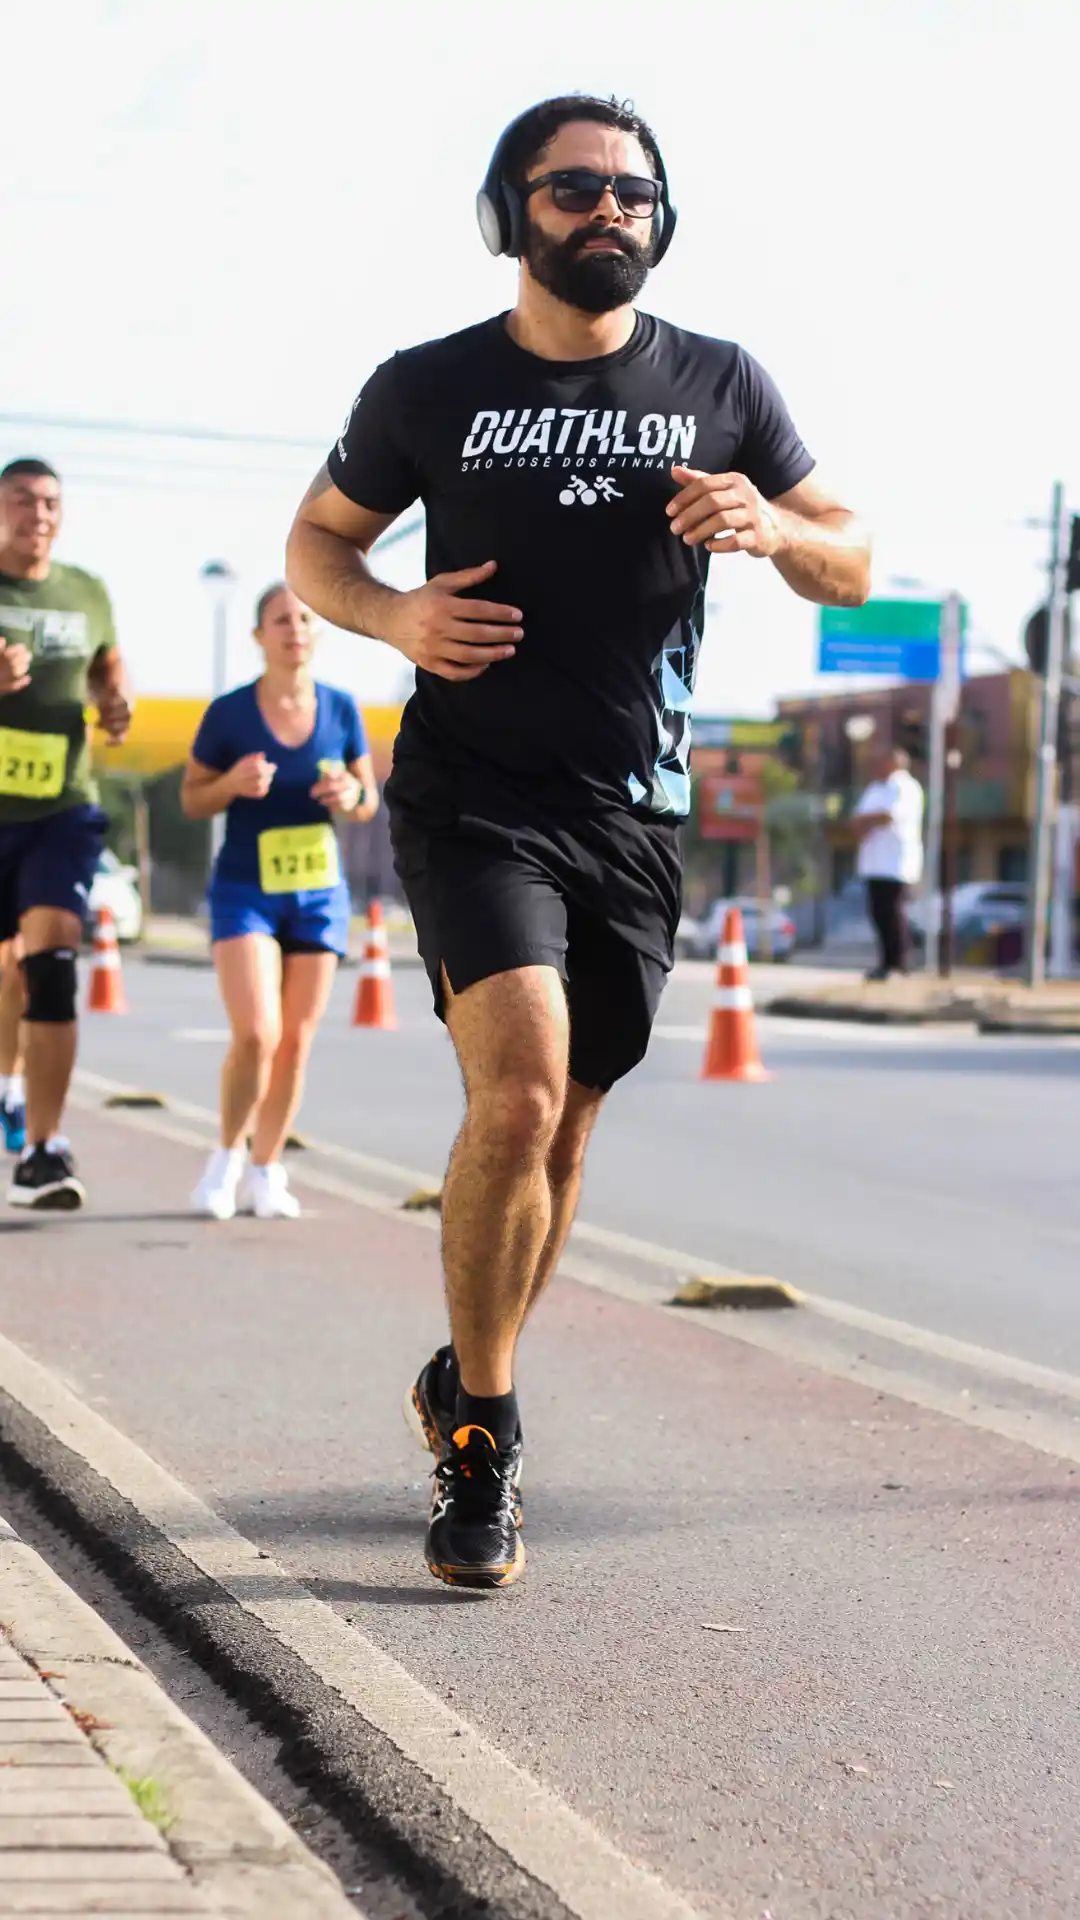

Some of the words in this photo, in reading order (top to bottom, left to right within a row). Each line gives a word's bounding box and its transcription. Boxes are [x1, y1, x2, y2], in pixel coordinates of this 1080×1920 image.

[461, 407, 697, 459] DUATHLON
[461, 458, 493, 472] SÃO
[504, 455, 552, 468] JOSÉ
[562, 457, 597, 468] DOS
[0, 755, 54, 783] 213
